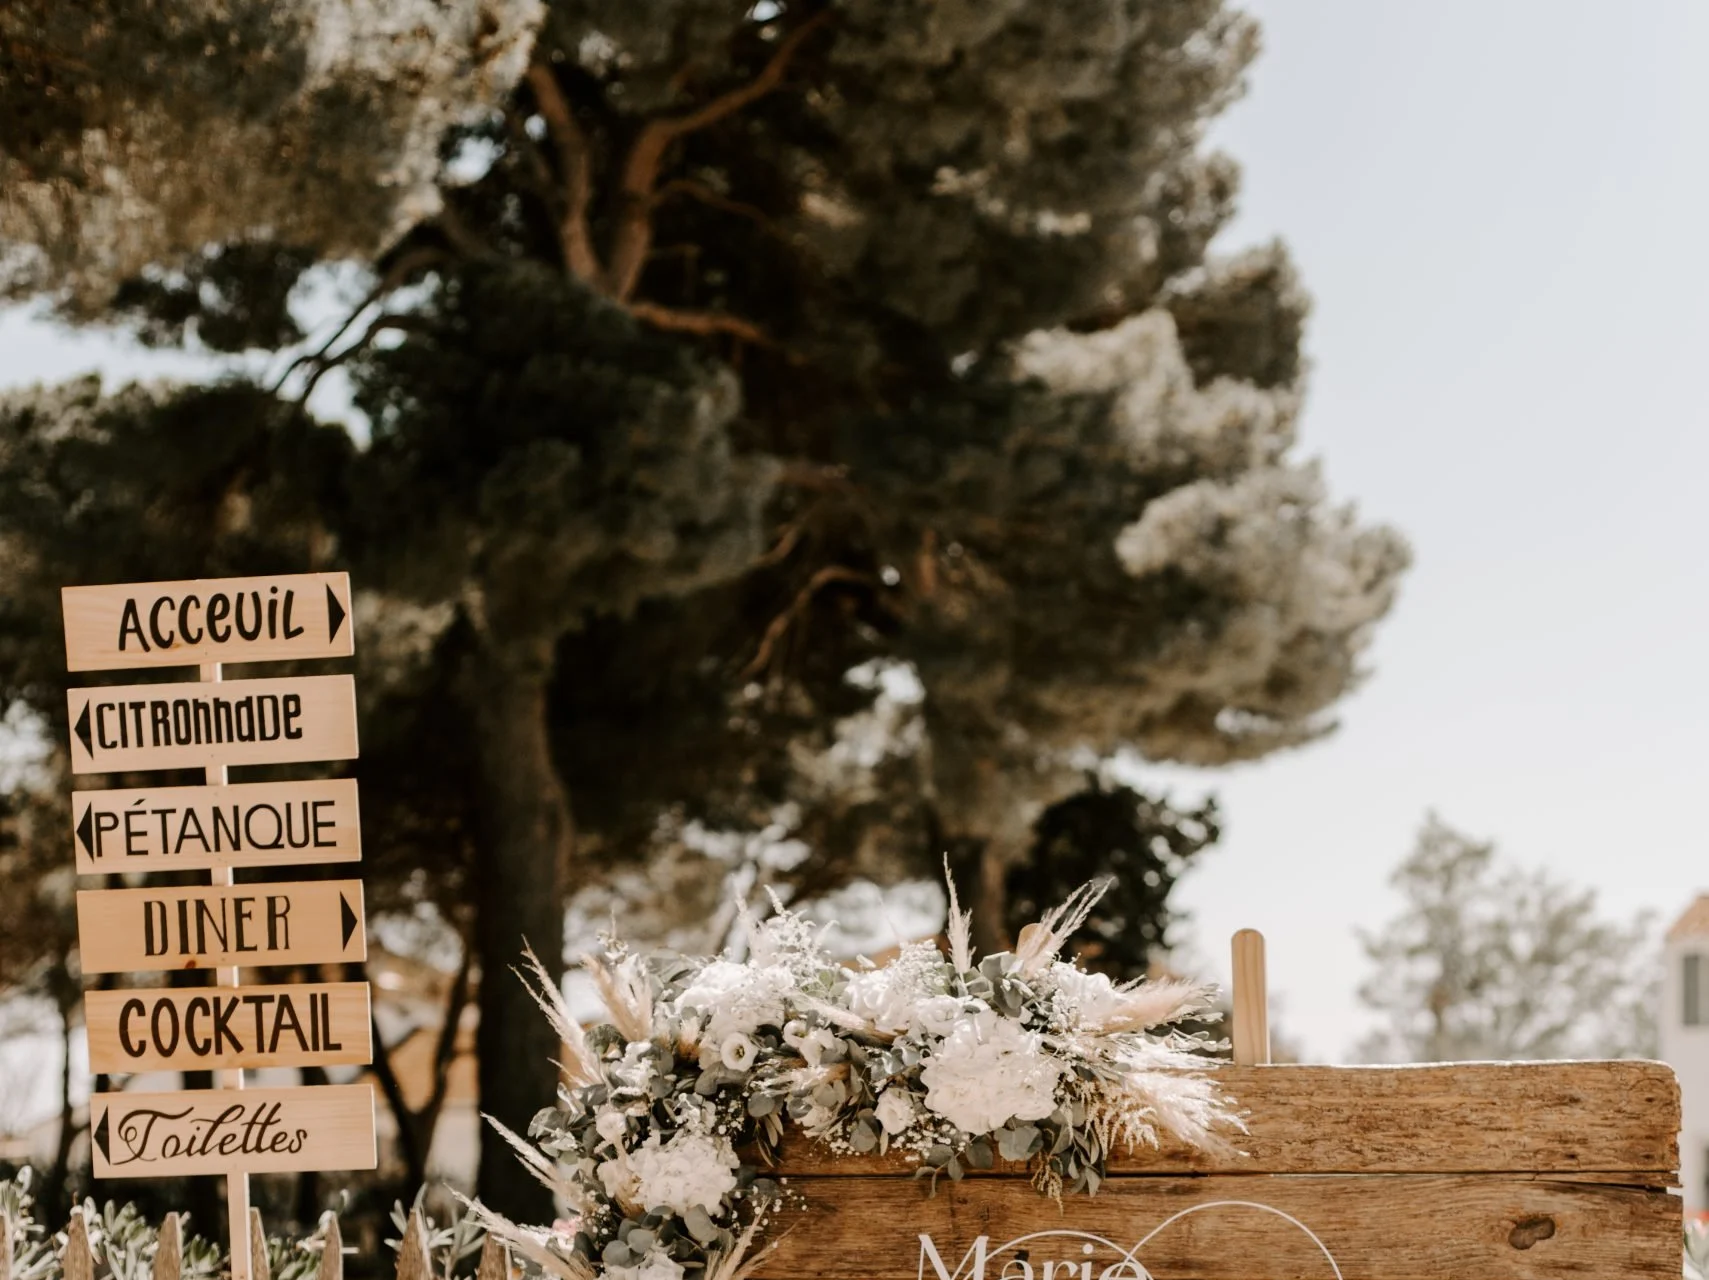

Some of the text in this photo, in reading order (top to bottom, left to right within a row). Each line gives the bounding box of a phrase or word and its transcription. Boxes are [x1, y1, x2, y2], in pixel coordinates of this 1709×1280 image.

[94, 798, 337, 857] PÉTANQUE
[143, 895, 291, 957] DINER
[118, 993, 342, 1058] COCKTAIL
[111, 1102, 308, 1165] Toilettes
